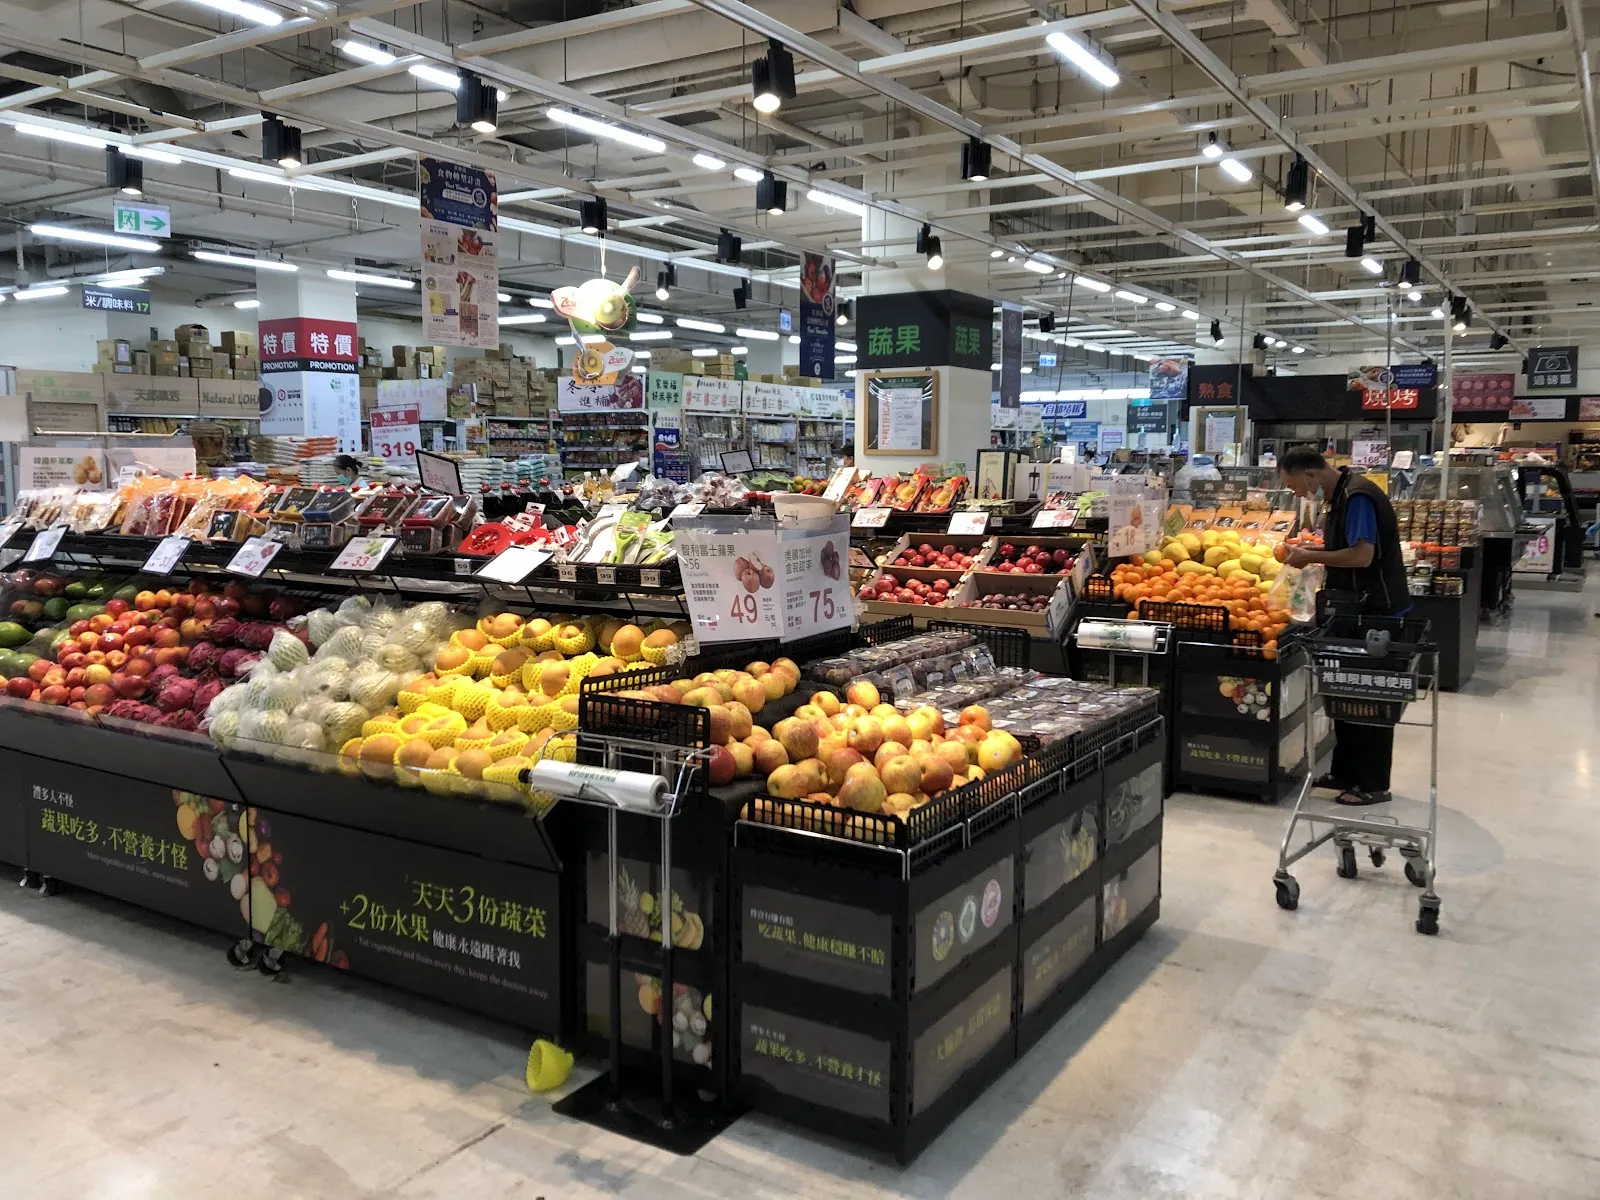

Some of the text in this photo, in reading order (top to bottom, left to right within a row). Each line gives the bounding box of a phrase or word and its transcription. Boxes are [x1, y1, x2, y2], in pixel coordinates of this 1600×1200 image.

[85, 295, 149, 312] 米/調味料 17
[262, 332, 297, 355] 特價
[310, 332, 353, 357] 特價
[868, 325, 921, 356] 蔬果
[955, 325, 981, 356] 蔬果
[262, 361, 299, 371] PROMOTION
[309, 360, 355, 372] PROMOTION
[202, 392, 236, 405] Natural
[1199, 381, 1233, 399] 熱食
[1364, 388, 1418, 406] 燒烤
[381, 440, 416, 458] 319
[352, 556, 370, 567] 33
[680, 543, 736, 558] 智利富士蘋果
[730, 593, 758, 624] 49
[809, 587, 835, 623] 75
[32, 784, 75, 808] 禮多人不怪
[339, 893, 429, 943] +2份水果
[412, 881, 547, 939] 天天3份蔬菜
[432, 928, 521, 971] 健康永遠跟著我
